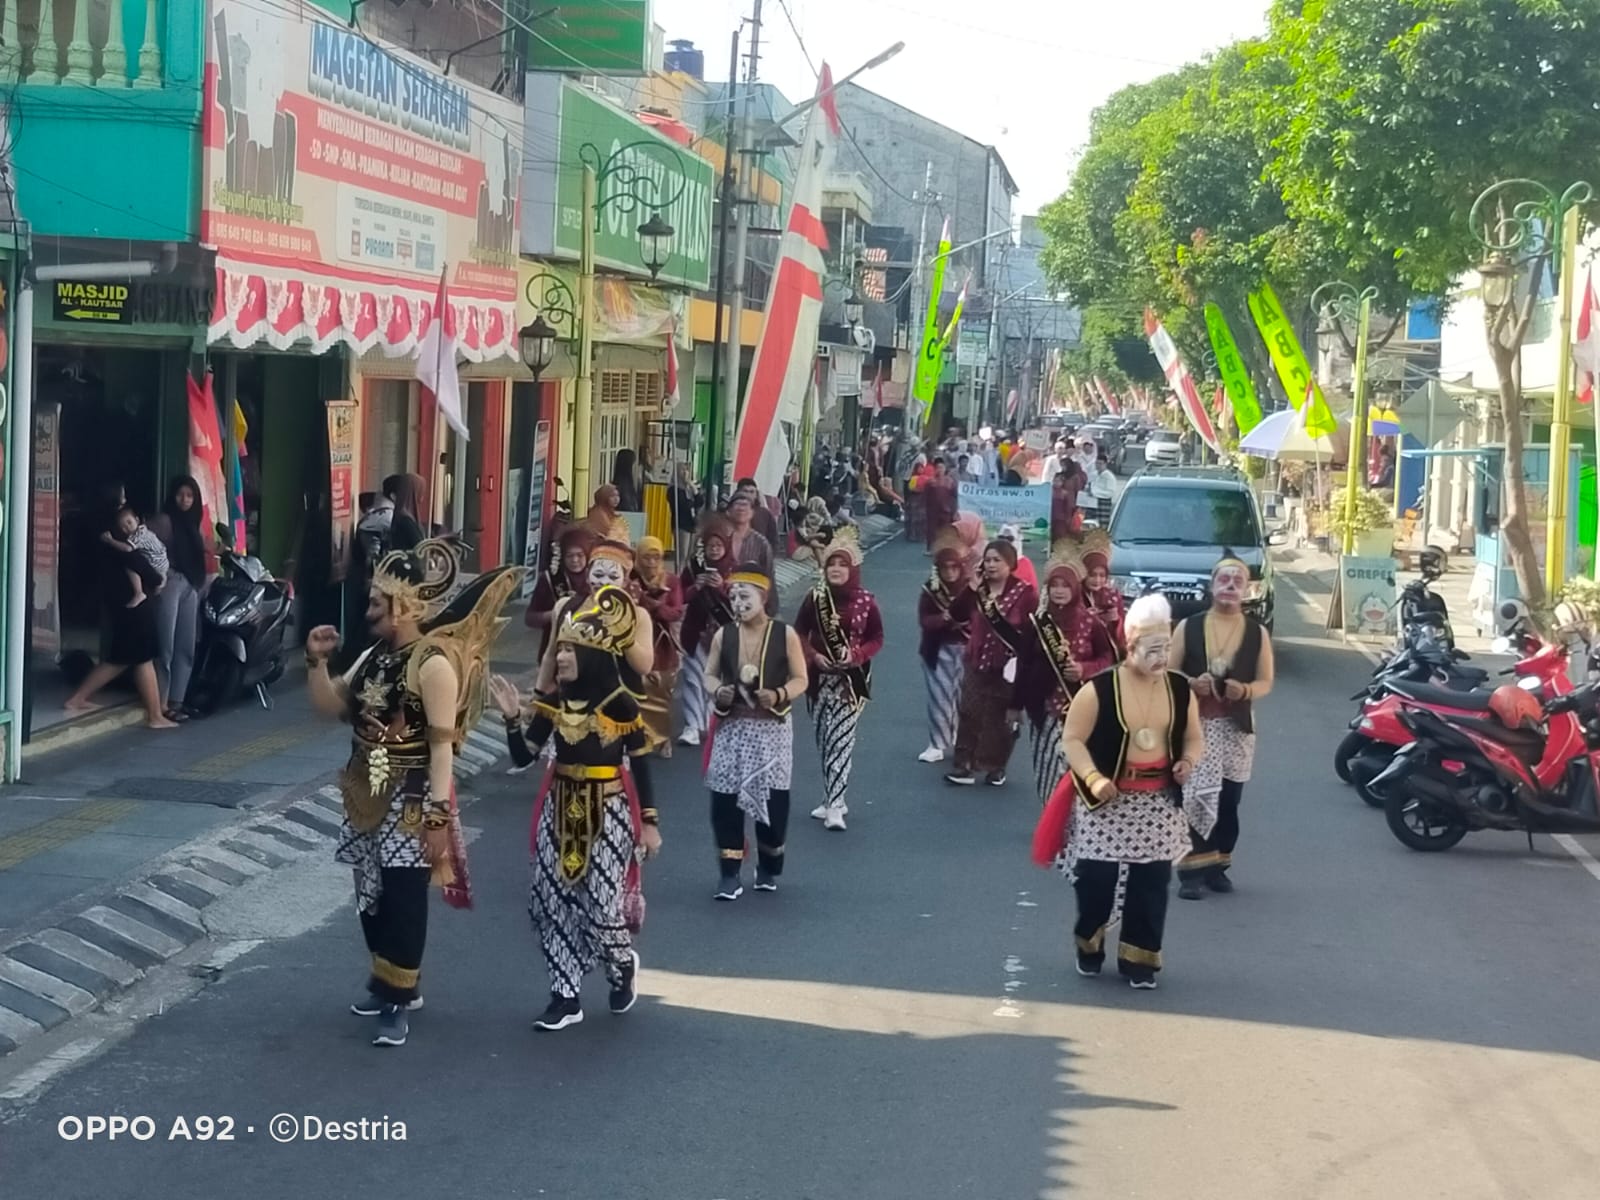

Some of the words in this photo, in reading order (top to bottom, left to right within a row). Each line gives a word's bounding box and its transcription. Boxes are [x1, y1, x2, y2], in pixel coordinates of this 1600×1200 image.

[312, 21, 397, 106] MAGETAN
[402, 63, 469, 146] SERAGAM
[57, 283, 128, 300] MASJID
[80, 299, 123, 308] KAUTSAR
